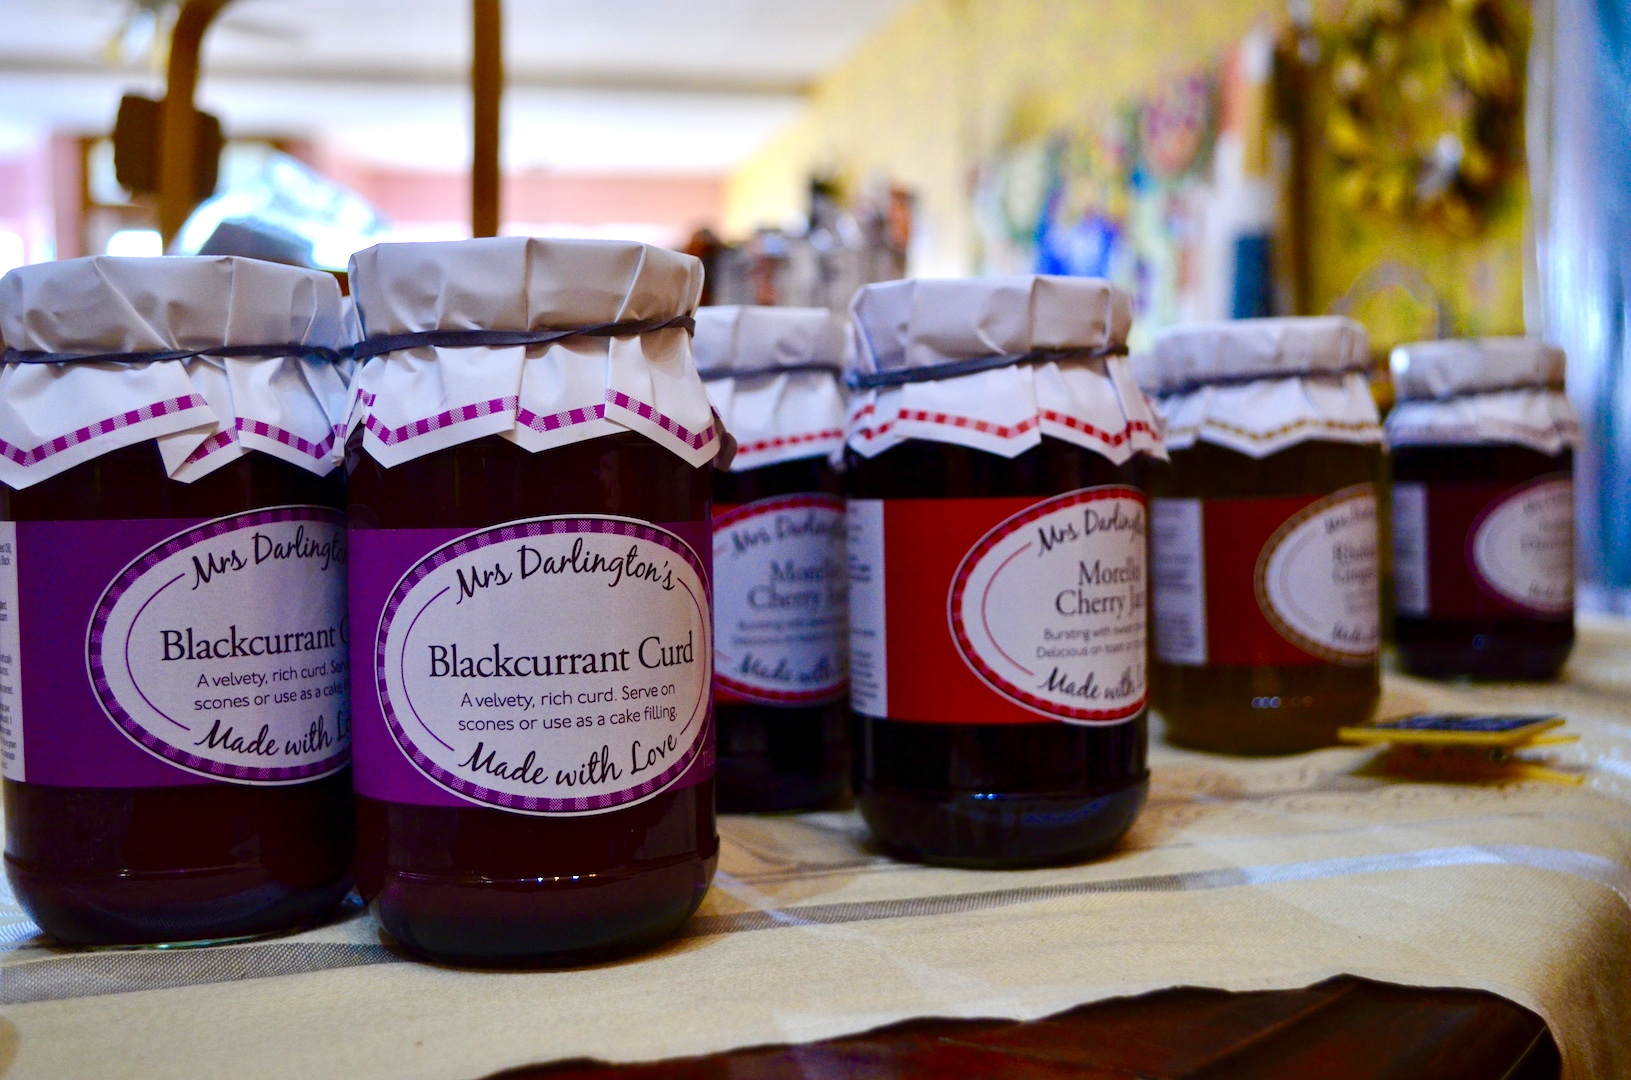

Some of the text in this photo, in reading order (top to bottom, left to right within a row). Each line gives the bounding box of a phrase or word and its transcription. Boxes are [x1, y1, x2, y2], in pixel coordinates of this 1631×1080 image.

[1037, 522, 1079, 557] Mrs
[192, 552, 248, 590] Mrs
[456, 537, 675, 604] Mrs Darlington's
[1078, 555, 1141, 586] Morello
[1055, 588, 1127, 619] Cherry
[160, 624, 336, 661] Blackcurrant
[1044, 627, 1090, 642] Bursting
[429, 643, 630, 678] Blackcurrant
[638, 630, 694, 669] Curd
[1036, 645, 1089, 660] Delicious
[197, 674, 209, 687] A
[211, 671, 268, 688] velvety,
[273, 666, 297, 682] rich
[301, 664, 329, 680] curd.
[1038, 665, 1101, 700] Made
[1104, 665, 1136, 700] with
[194, 697, 250, 711] scones
[254, 695, 271, 708] or
[274, 692, 297, 705] use
[300, 689, 313, 701] as
[315, 688, 321, 698] a
[323, 682, 343, 697] cake
[460, 683, 676, 710] A velvety, rich curd. Serve on
[458, 704, 678, 731] scones or use as a cake filling.
[194, 720, 279, 756] Made
[285, 715, 333, 756] with
[458, 742, 548, 785] Made
[556, 745, 623, 787] with
[631, 734, 677, 775] Love
